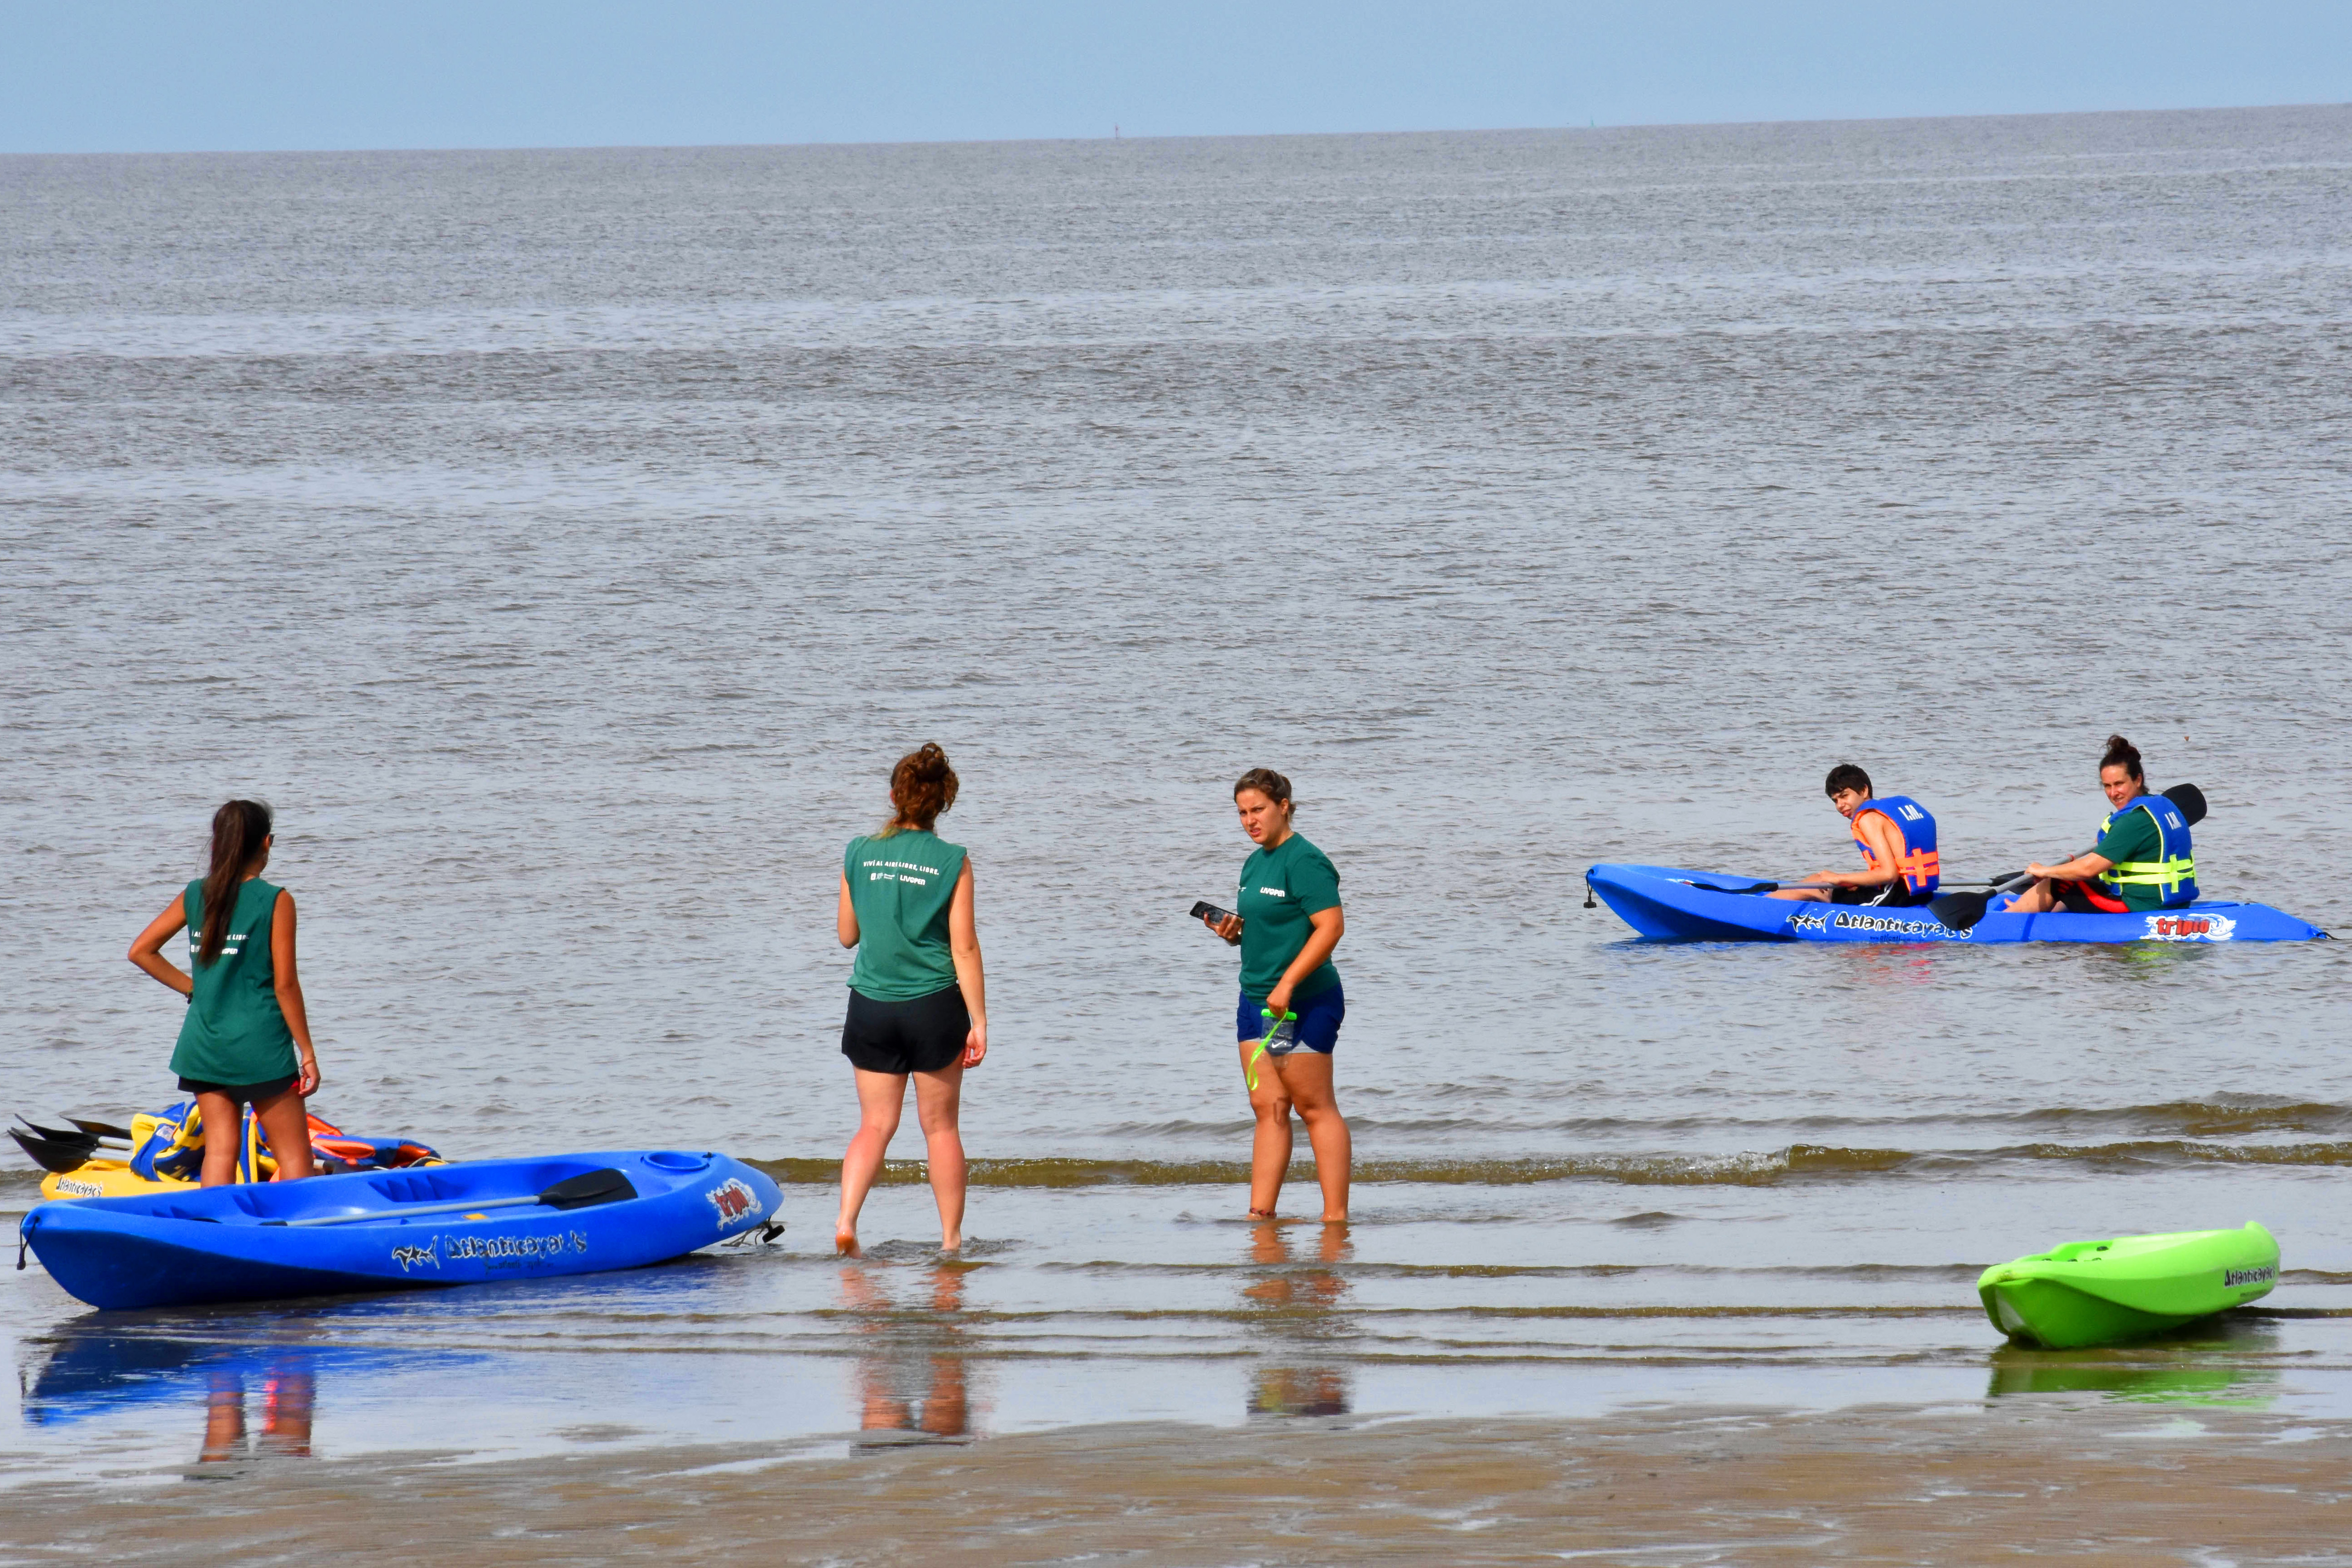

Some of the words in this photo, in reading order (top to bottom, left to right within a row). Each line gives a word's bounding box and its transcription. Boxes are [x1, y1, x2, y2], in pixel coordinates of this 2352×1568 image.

[1898, 805, 1924, 821] I.M.
[899, 863, 918, 871] LIBRE,
[920, 865, 939, 875] LIBRE.
